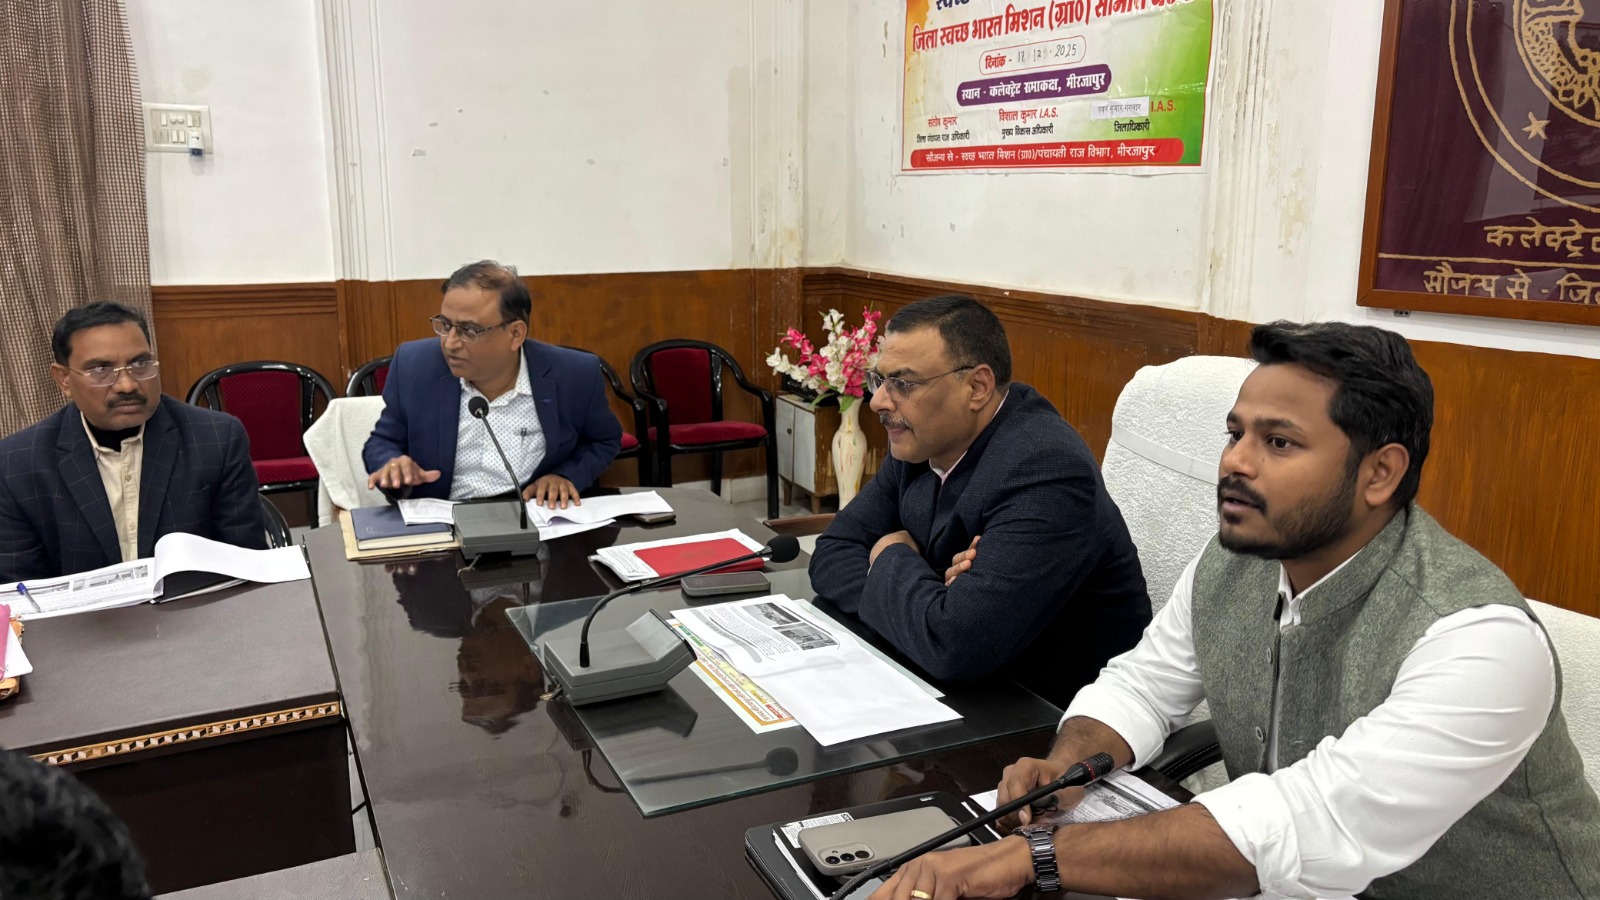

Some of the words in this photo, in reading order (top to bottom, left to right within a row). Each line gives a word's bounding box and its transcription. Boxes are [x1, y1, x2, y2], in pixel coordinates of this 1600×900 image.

[912, 24, 938, 52] जिला
[940, 22, 970, 46] स्वच्छ
[972, 15, 1003, 40] भारत
[1005, 4, 1046, 35] मिशन
[985, 53, 1006, 69] दिनांक
[1066, 72, 1106, 90] मीरजापुर
[1150, 100, 1176, 113] I.A.S.
[999, 108, 1018, 121] विशाल
[1020, 109, 1038, 123] कुमार
[1031, 122, 1054, 135] अधिकारी
[1114, 118, 1150, 133] जिलाधिकारी
[947, 149, 954, 161] से
[978, 150, 995, 160] भारत
[997, 148, 1016, 160] मिशन
[1069, 147, 1084, 158] राज
[1117, 143, 1155, 160] मीरजापुर
[1484, 217, 1600, 258] कलेक्ट्रे
[1423, 262, 1499, 298] सौजन्य
[1506, 268, 1532, 300] से
[1556, 273, 1600, 305] जि
